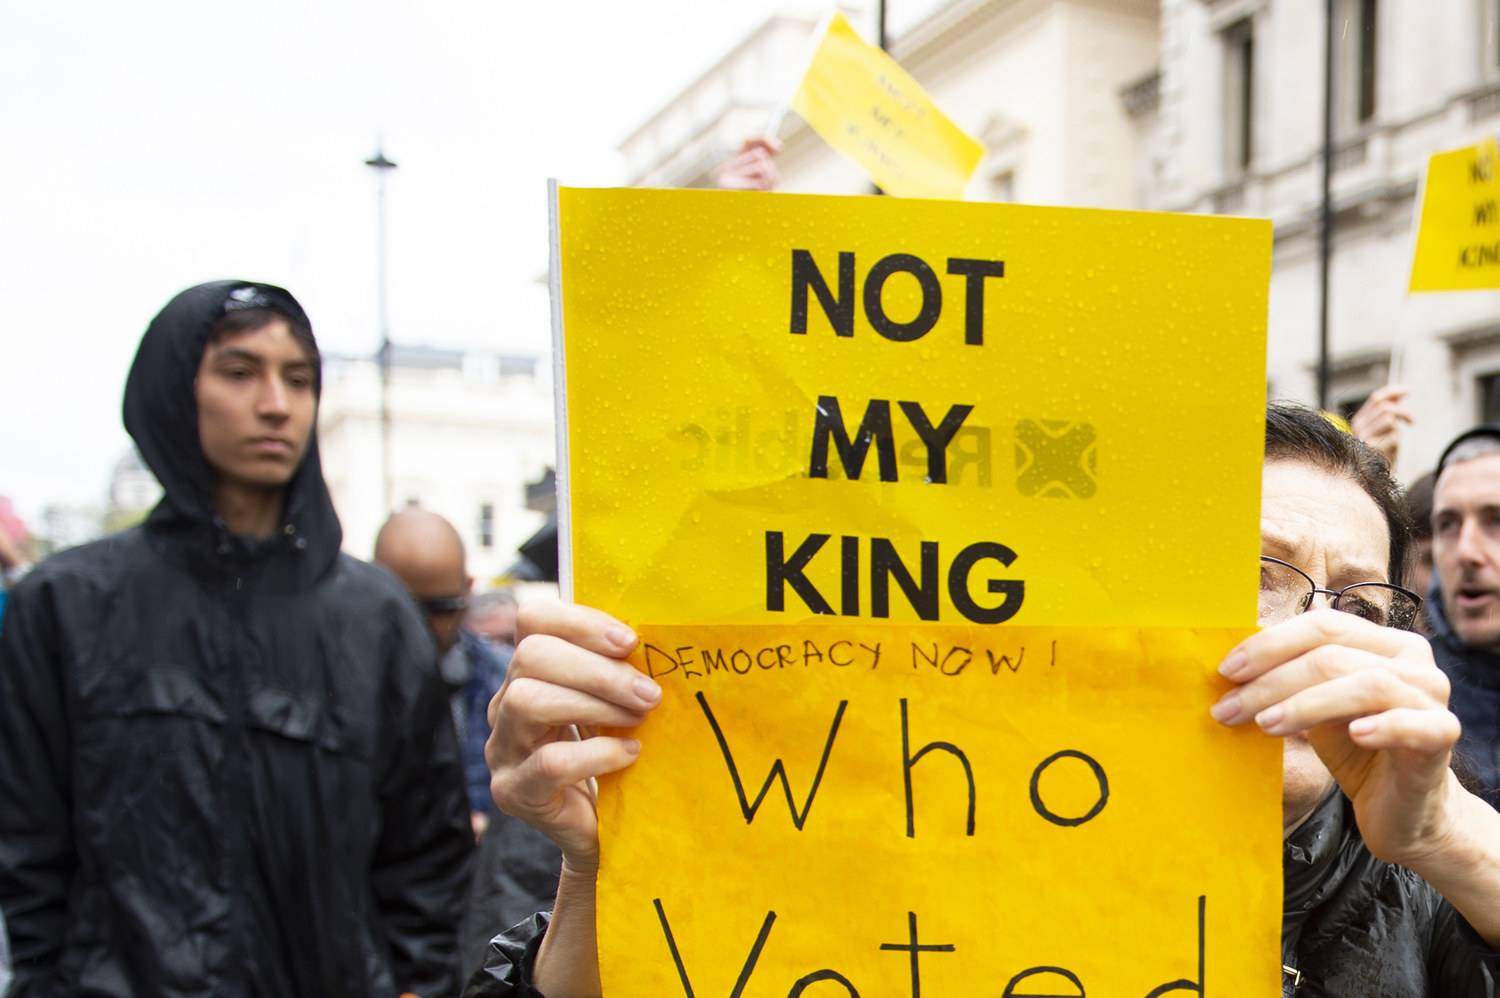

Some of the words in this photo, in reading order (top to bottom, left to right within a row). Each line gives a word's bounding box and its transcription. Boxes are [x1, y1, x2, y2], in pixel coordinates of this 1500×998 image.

[789, 248, 1005, 347] NOT
[808, 395, 975, 486] MY
[764, 530, 1026, 625] KING
[643, 640, 883, 679] DEMOCRACY
[694, 690, 1110, 839] Who
